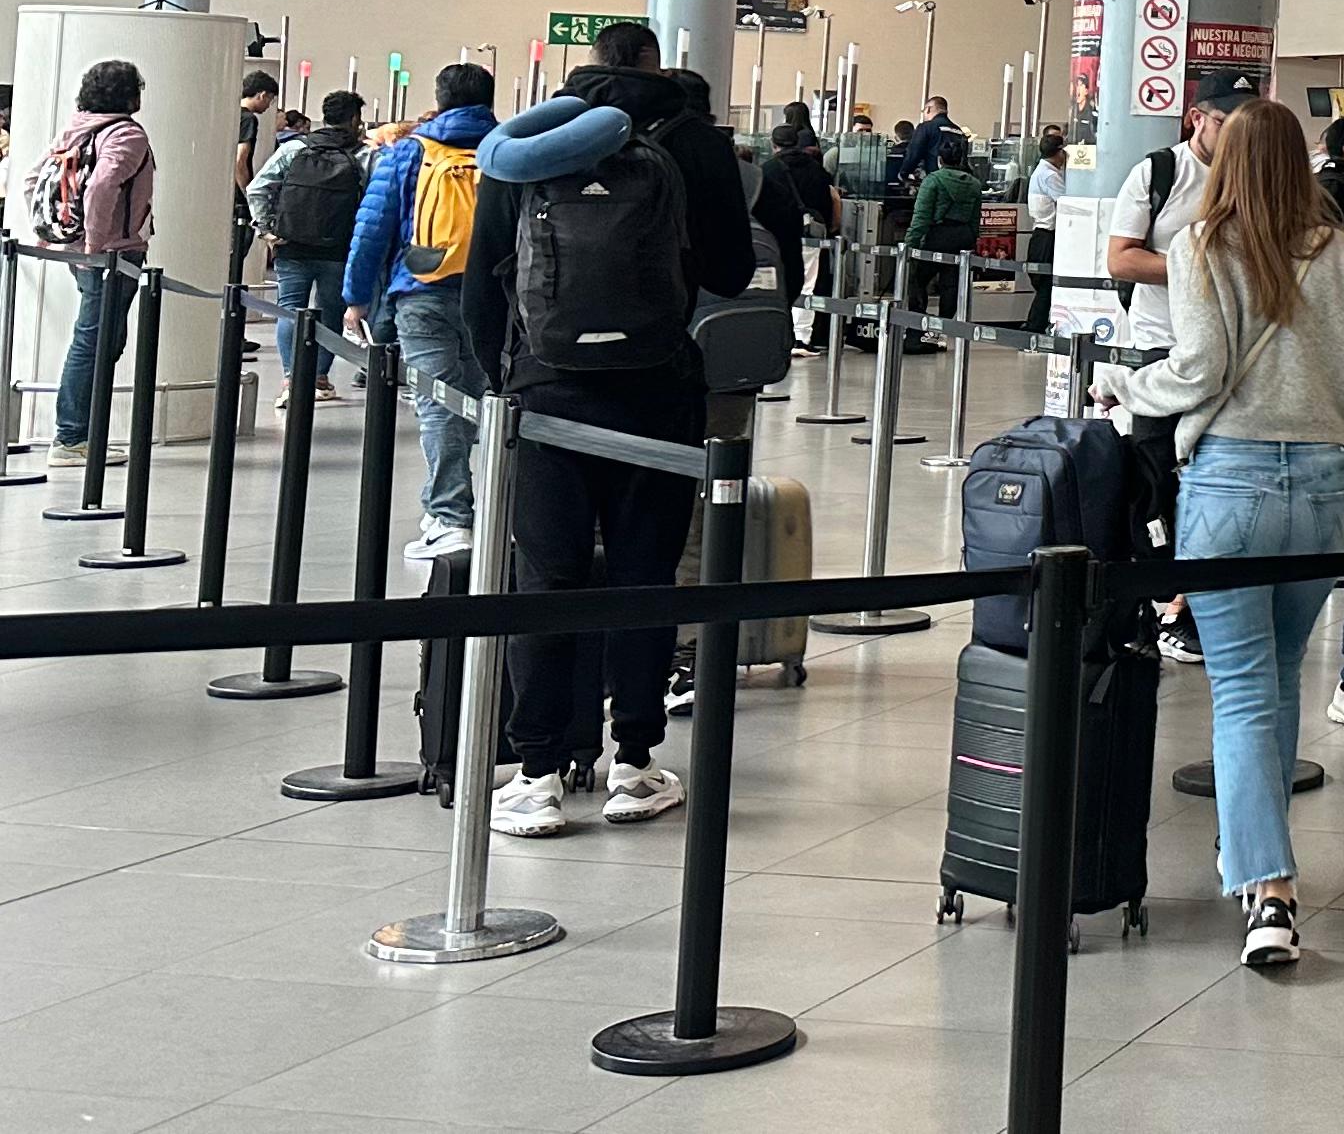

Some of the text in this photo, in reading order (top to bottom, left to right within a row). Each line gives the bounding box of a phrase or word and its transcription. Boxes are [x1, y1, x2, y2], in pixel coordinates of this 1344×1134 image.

[1190, 28, 1240, 43] ¡NUESTRA
[1197, 42, 1214, 56] NO
[1217, 43, 1230, 57] SE
